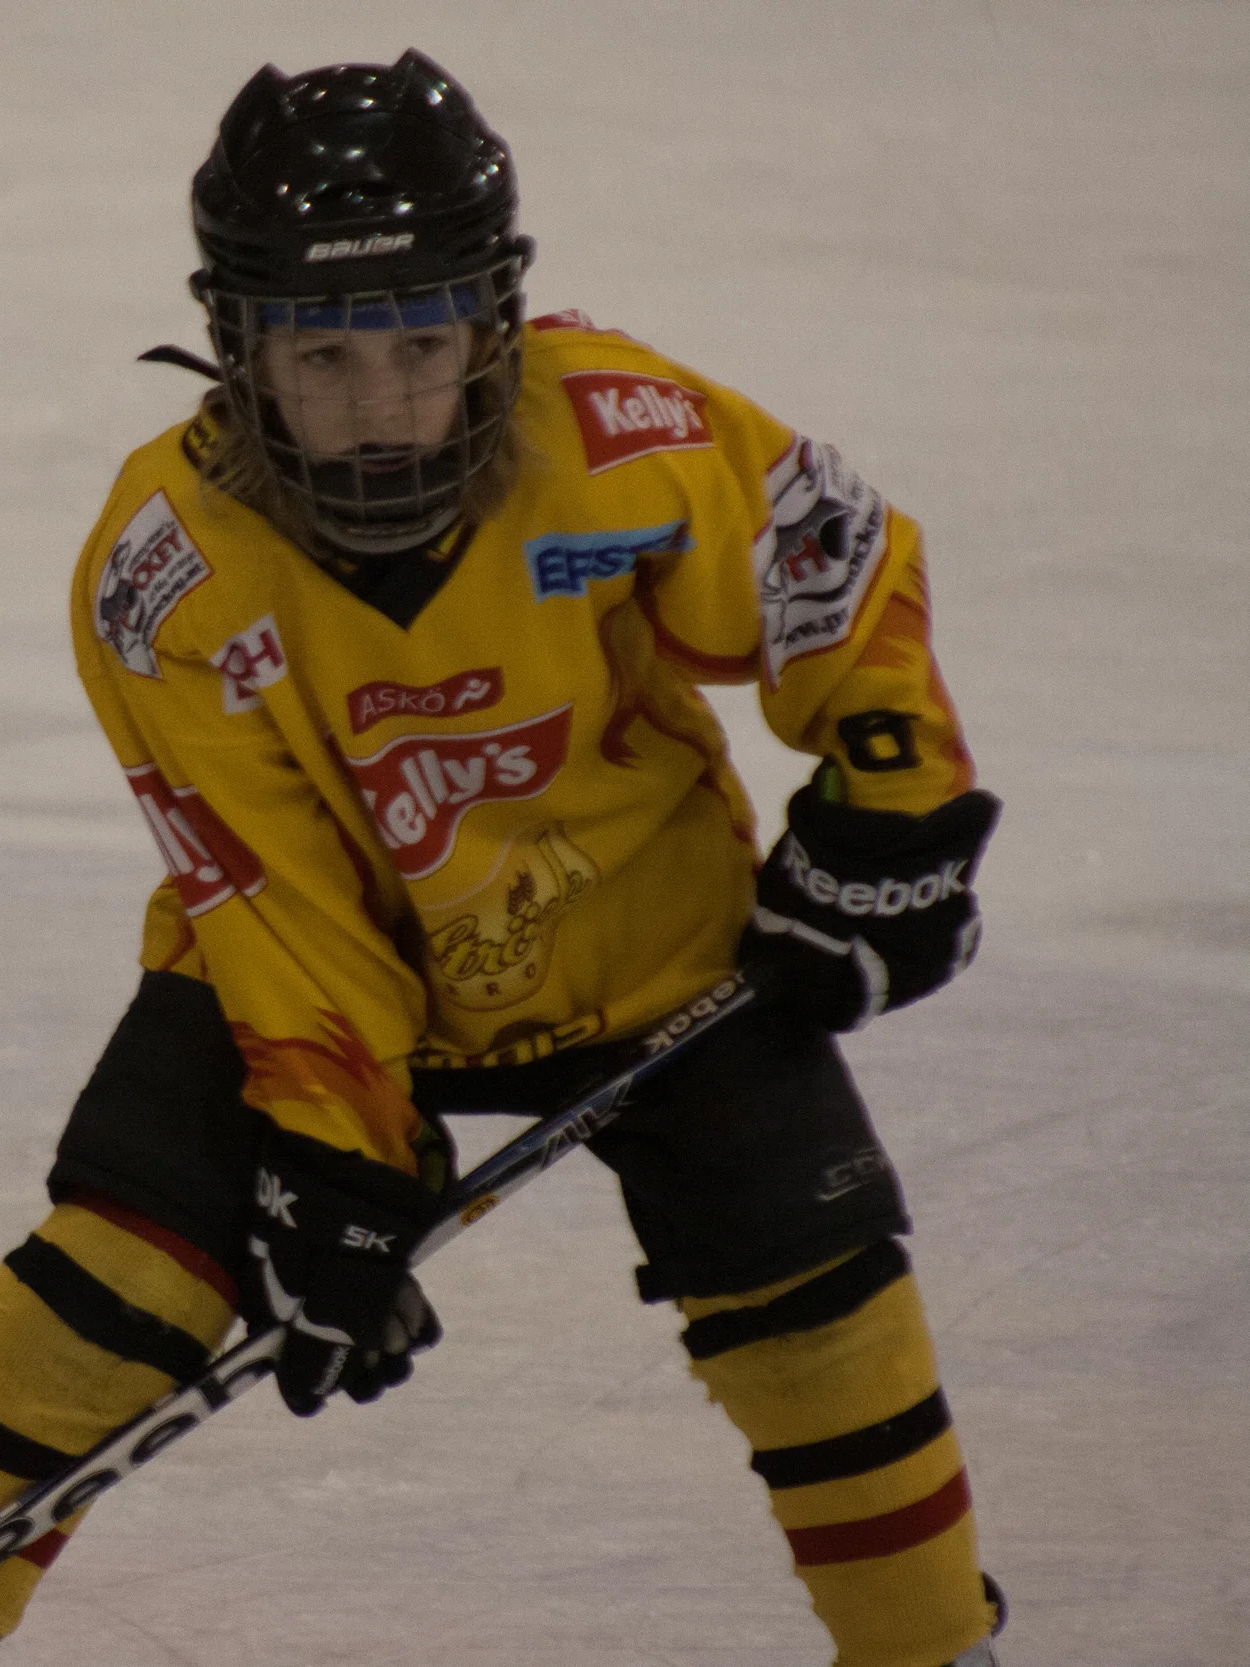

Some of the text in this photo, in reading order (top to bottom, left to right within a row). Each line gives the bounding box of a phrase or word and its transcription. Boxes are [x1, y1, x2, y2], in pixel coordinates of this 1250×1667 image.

[302, 231, 416, 263] BAUER
[359, 686, 446, 725] ASKÖ
[783, 830, 969, 917] Reebok
